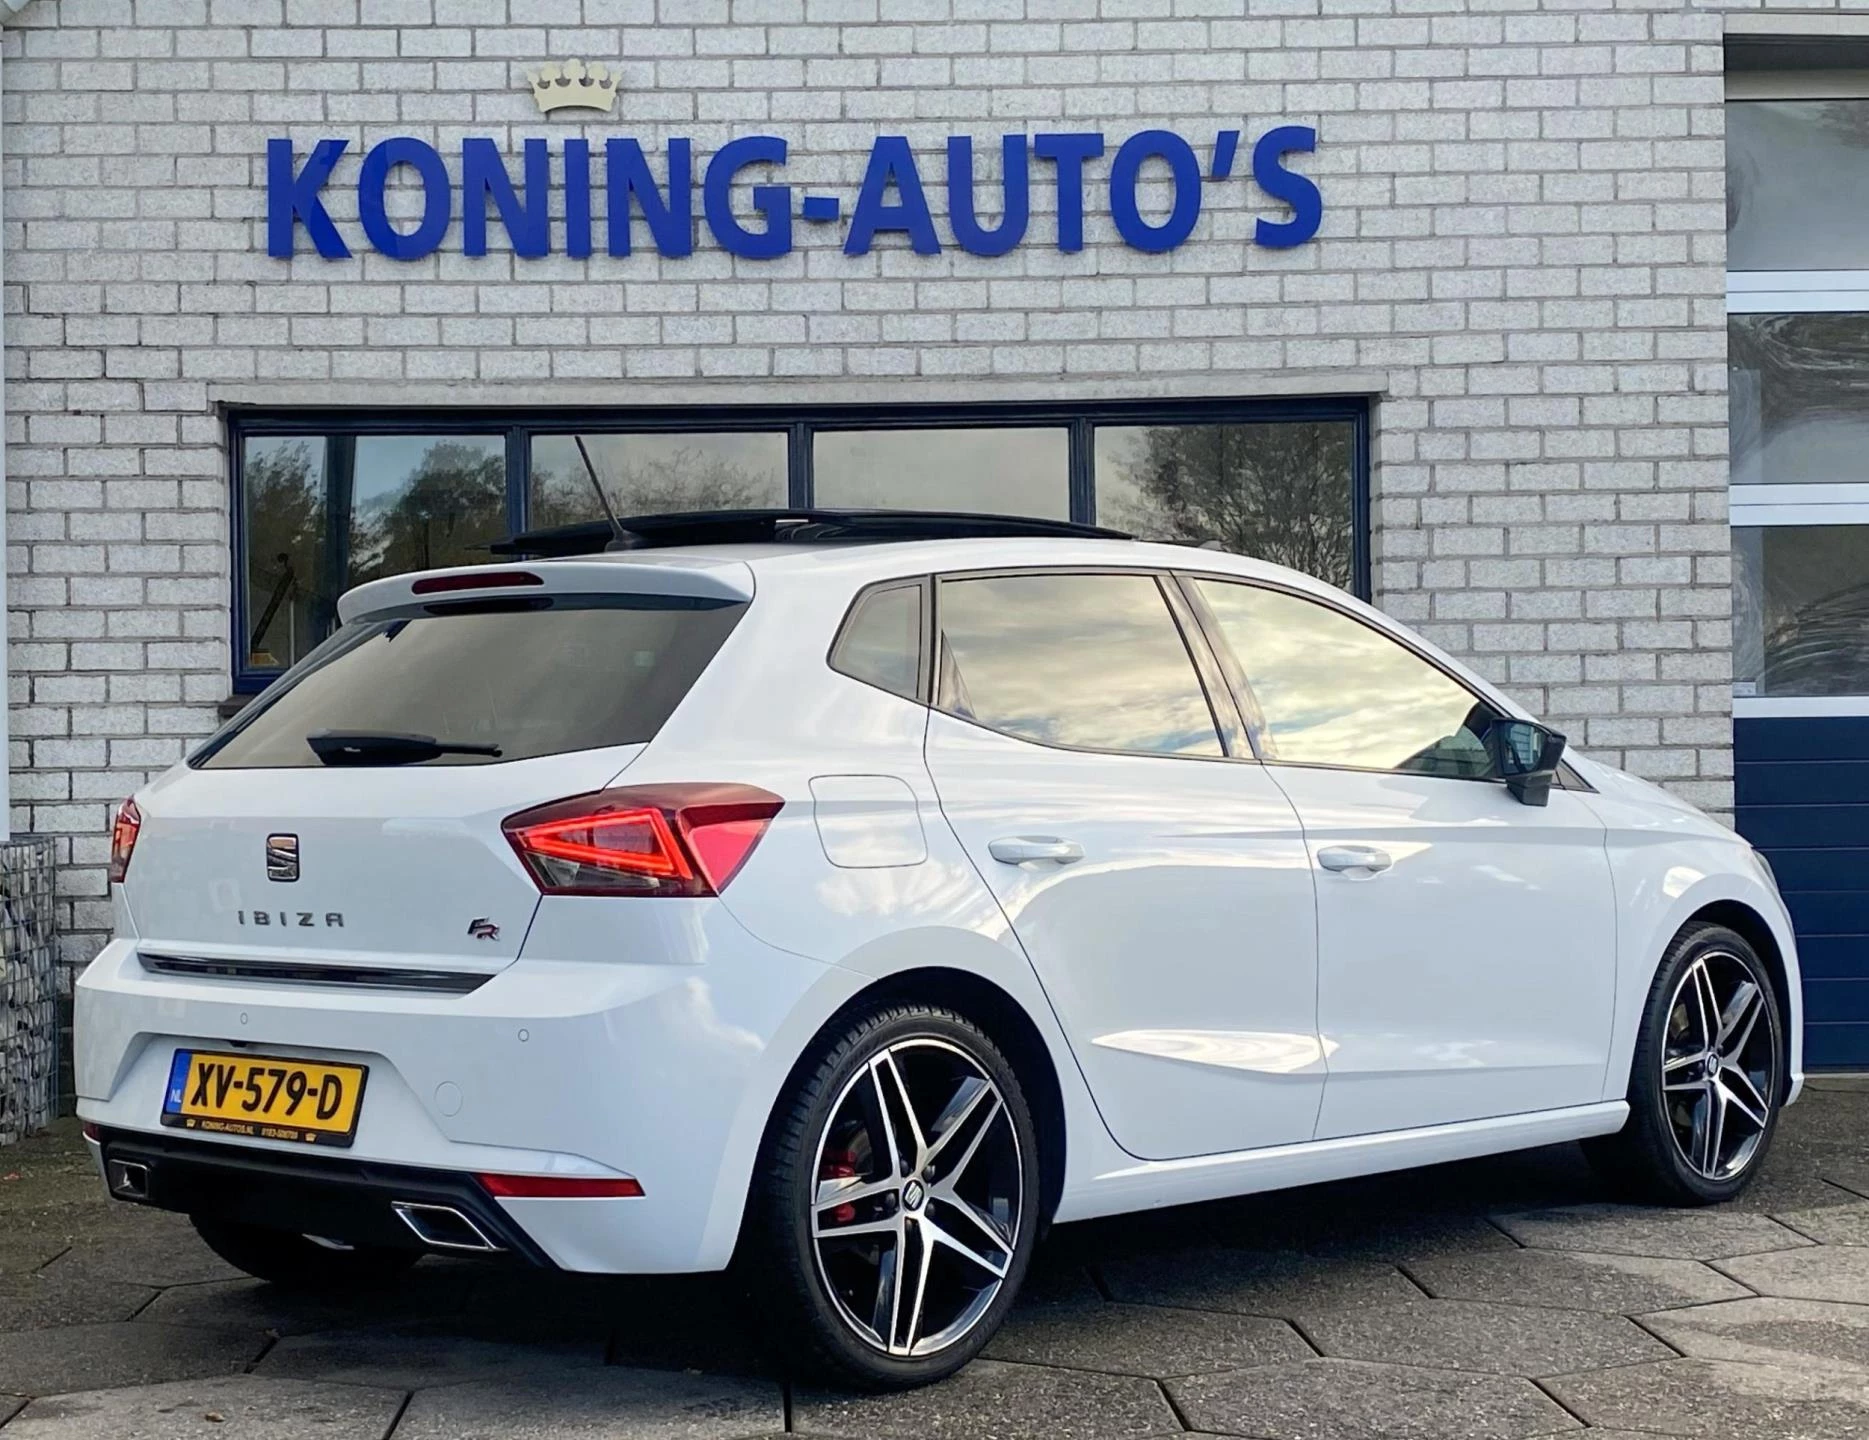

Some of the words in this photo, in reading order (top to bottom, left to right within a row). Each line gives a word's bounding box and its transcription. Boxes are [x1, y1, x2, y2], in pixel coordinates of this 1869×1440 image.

[267, 125, 1323, 259] KONING-AUTO'S
[239, 911, 345, 927] IBIZA
[467, 917, 500, 941] FR
[170, 1089, 182, 1103] NL
[191, 1063, 342, 1120] XV-579-D
